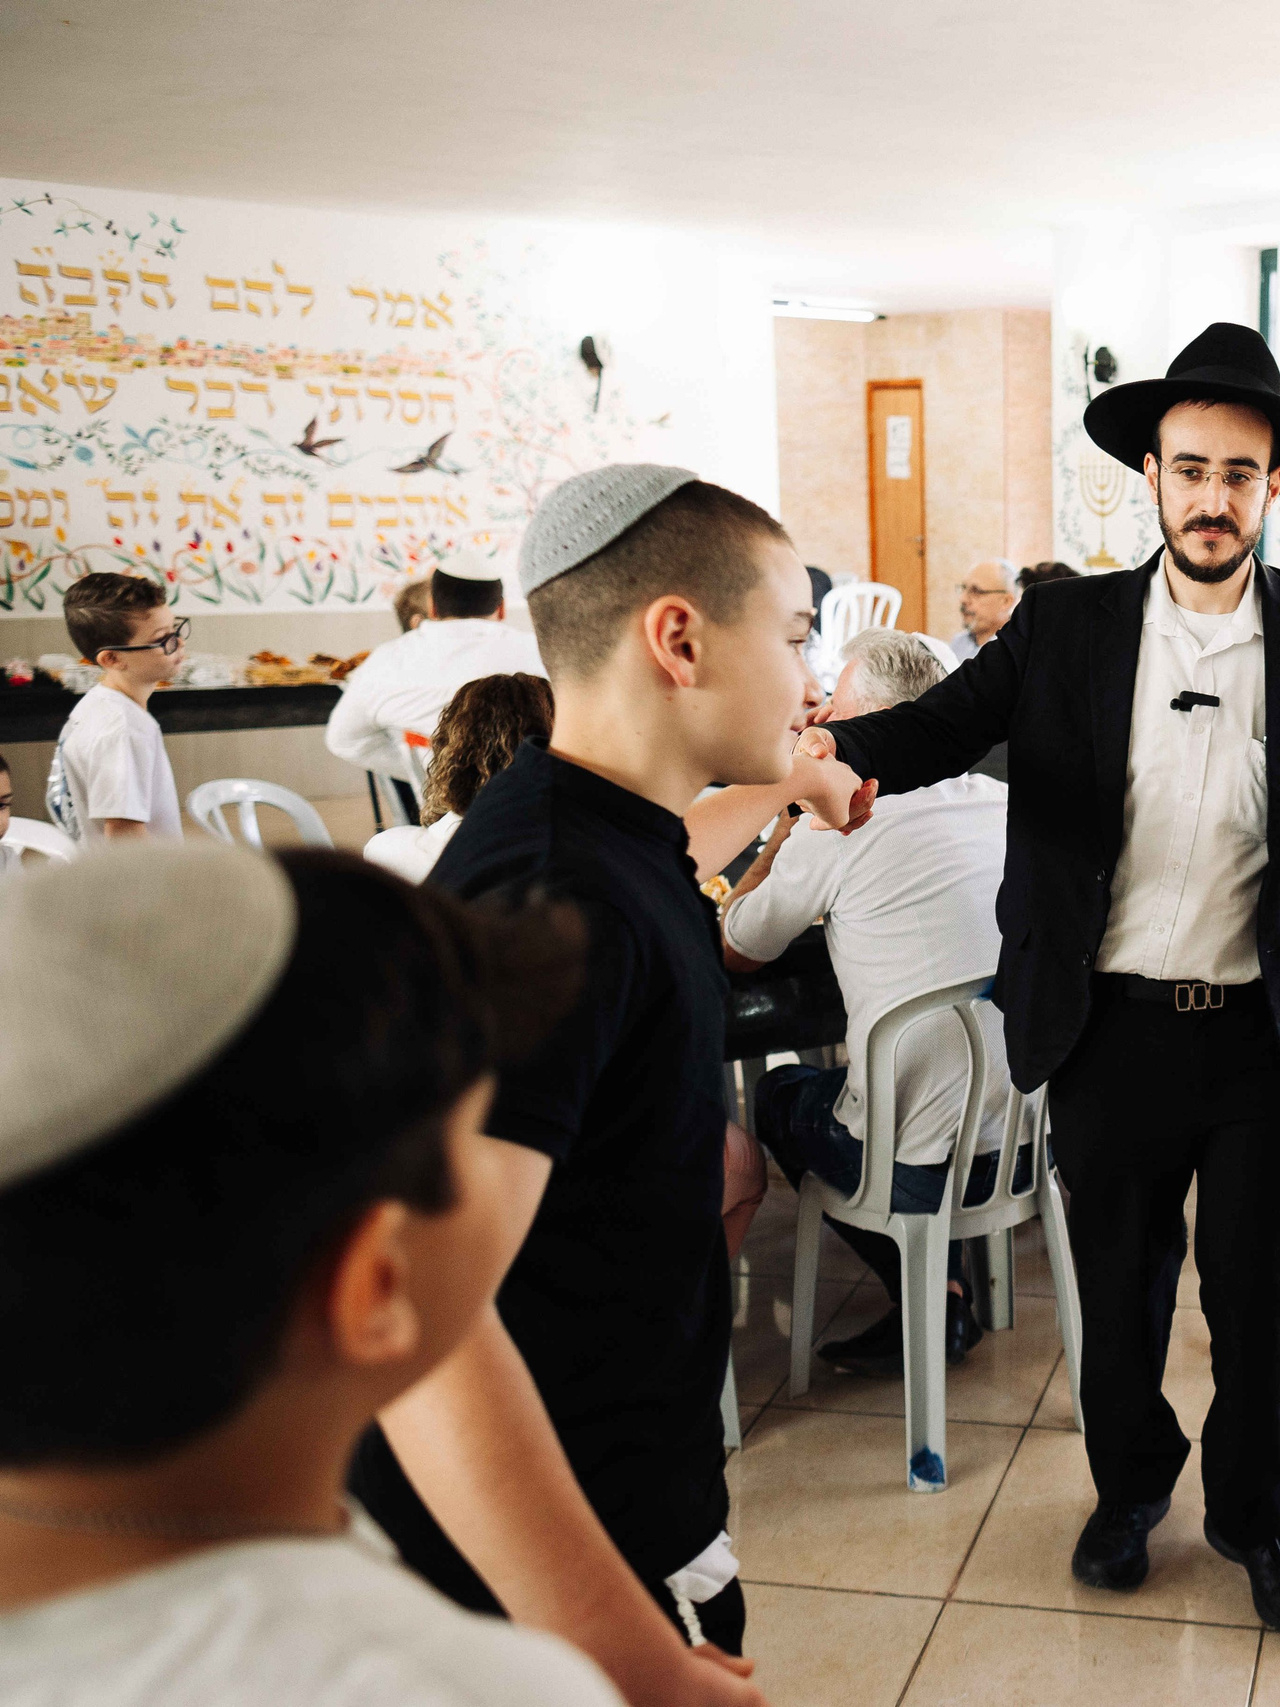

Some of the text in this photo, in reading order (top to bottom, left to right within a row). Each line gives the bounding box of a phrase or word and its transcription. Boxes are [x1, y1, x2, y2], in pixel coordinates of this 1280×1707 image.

[204, 260, 316, 319] להם
[347, 283, 454, 330] אמר
[164, 374, 276, 420] דבר
[304, 383, 459, 425] חסרתי
[104, 487, 160, 529] זה
[177, 480, 243, 531] את
[262, 491, 305, 529] זה
[326, 490, 470, 529] אוהבים
